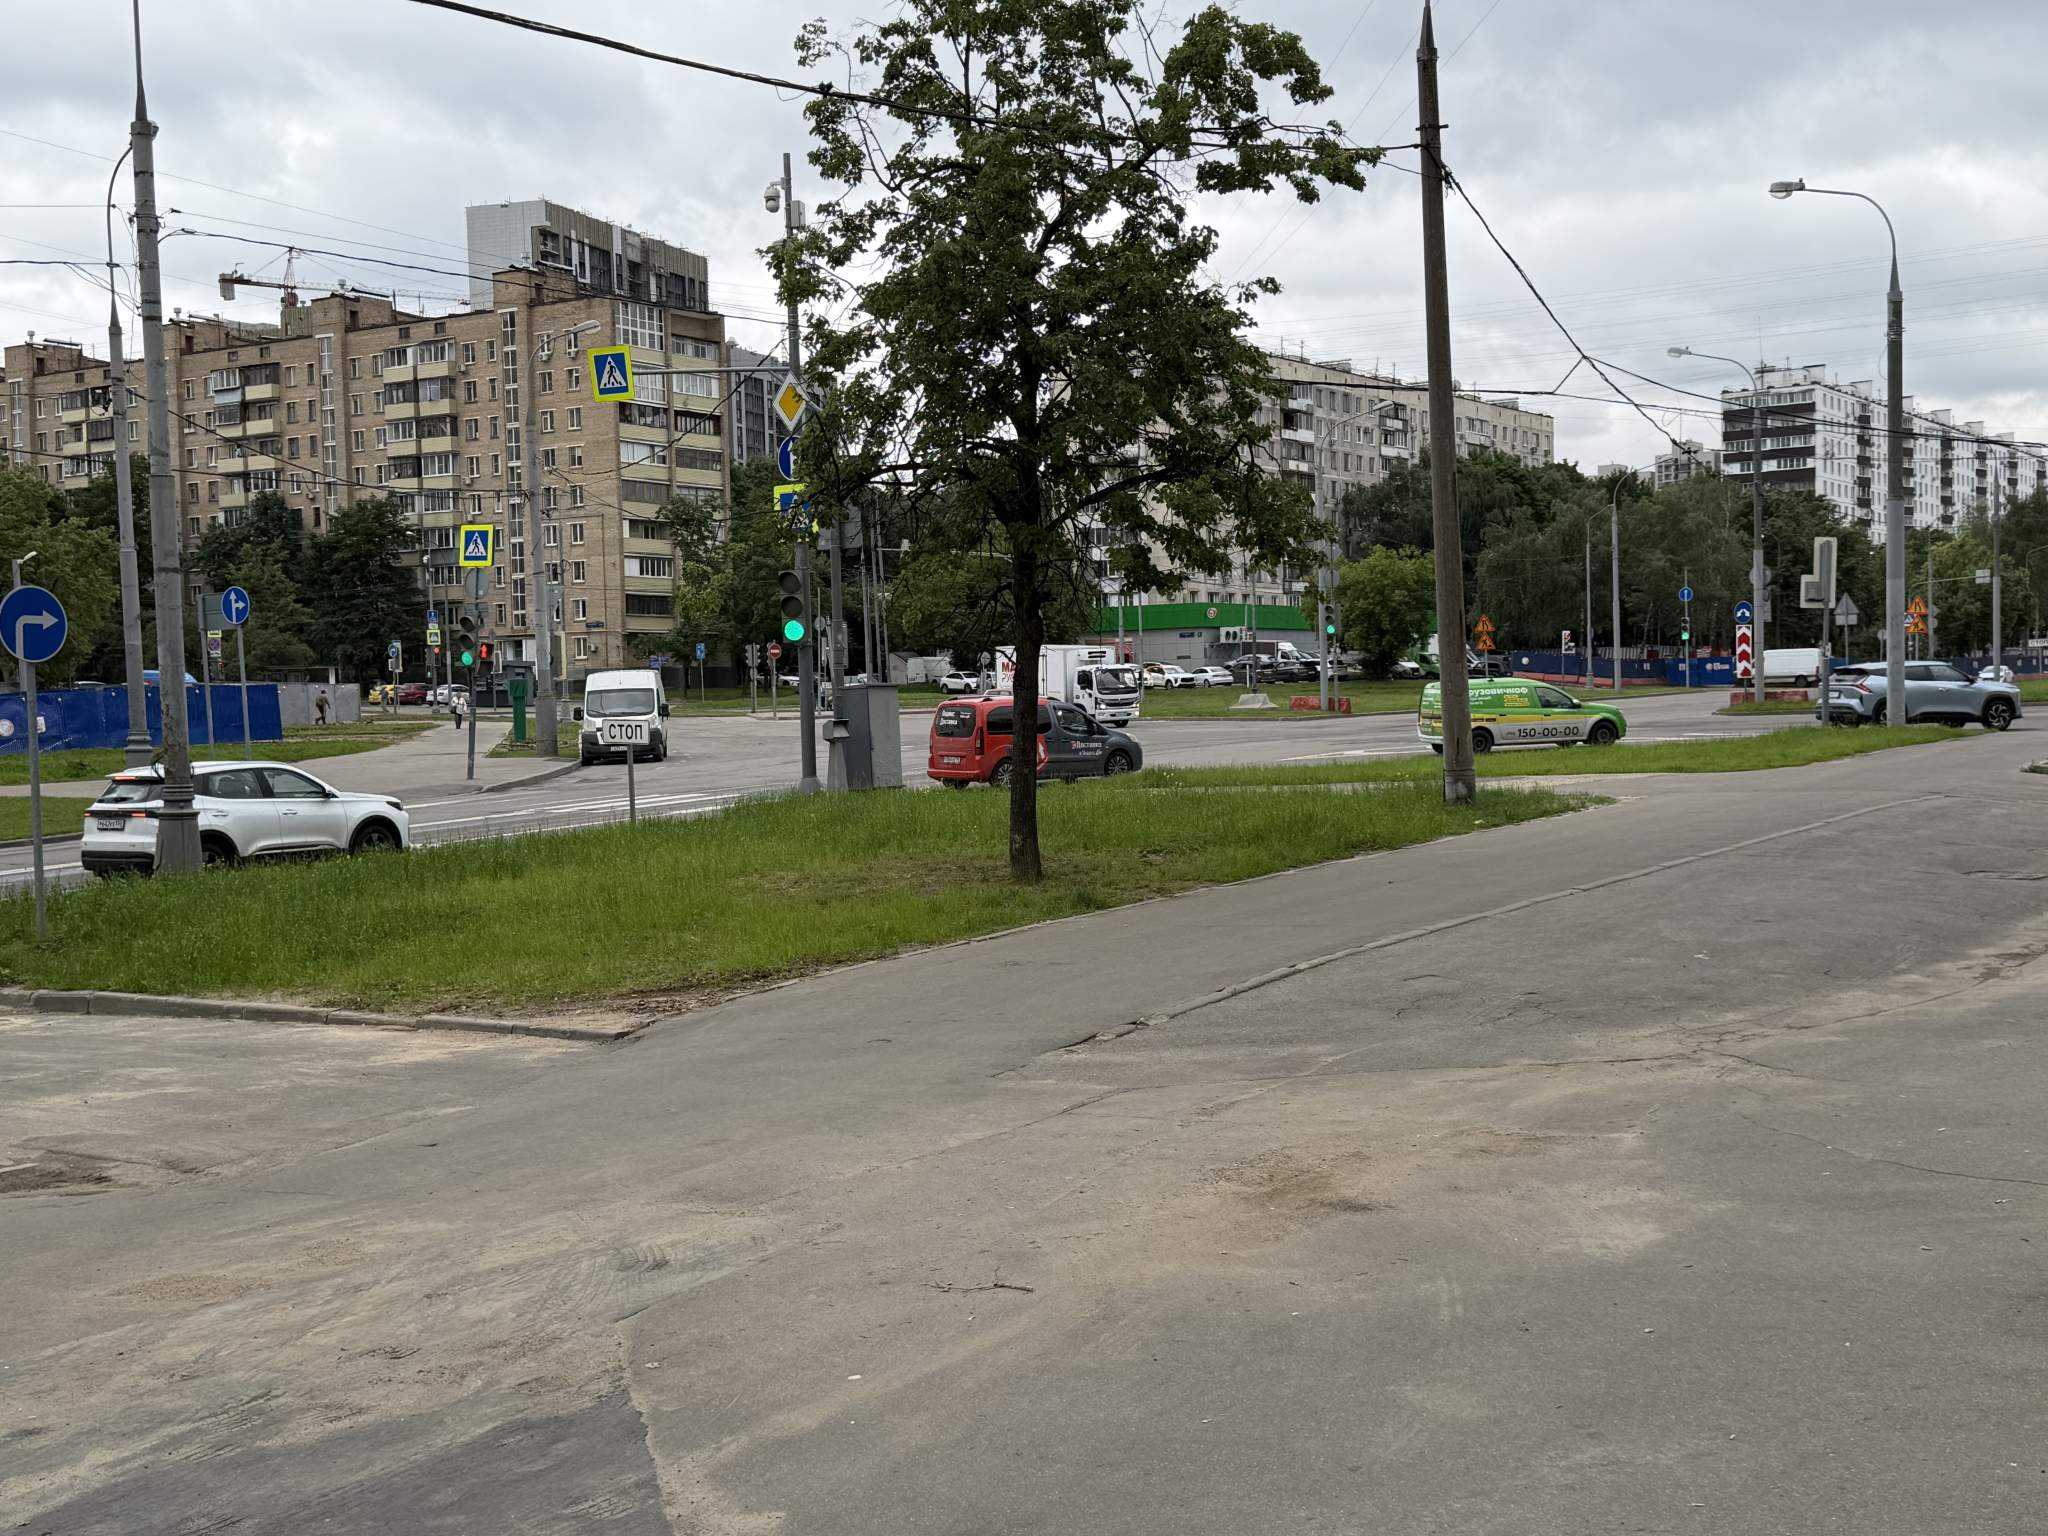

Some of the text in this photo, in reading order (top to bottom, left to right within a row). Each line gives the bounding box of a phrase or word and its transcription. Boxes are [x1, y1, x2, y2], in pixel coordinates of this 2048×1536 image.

[1469, 687, 1528, 697] рузовичкоф
[609, 723, 642, 740] СТОП
[1518, 726, 1579, 737] 150-00-00
